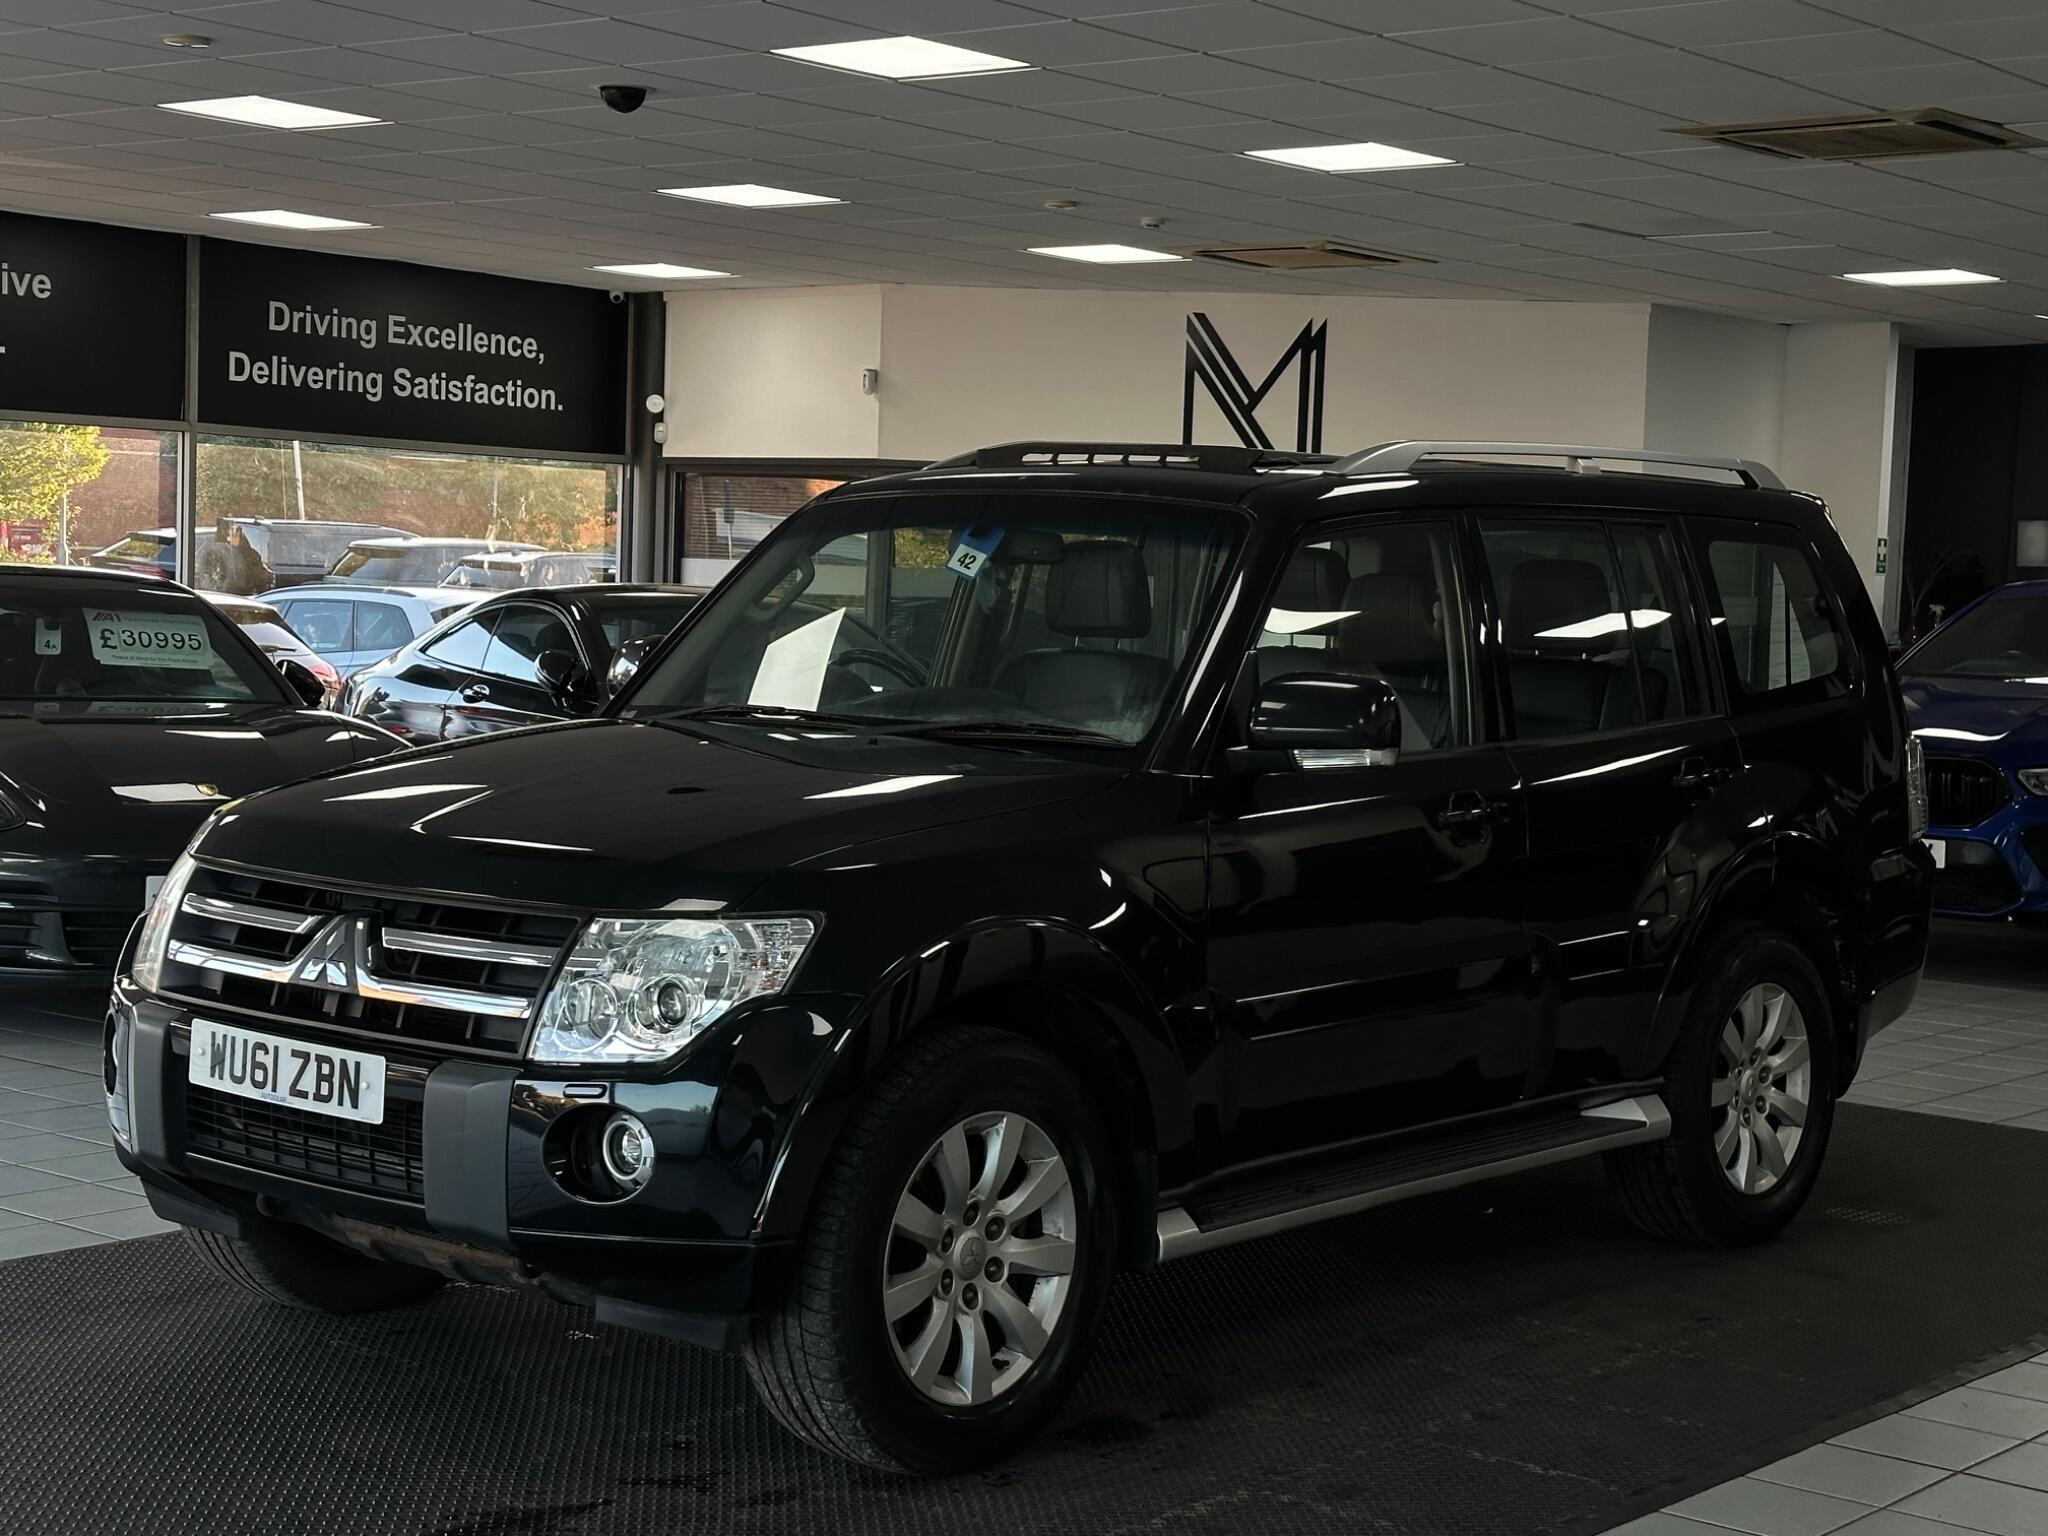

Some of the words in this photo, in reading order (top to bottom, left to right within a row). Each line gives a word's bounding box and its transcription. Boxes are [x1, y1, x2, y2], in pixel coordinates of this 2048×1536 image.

[268, 301, 377, 349] Driving
[387, 314, 545, 365] Excellence,
[228, 351, 383, 401] Delivering
[392, 367, 564, 411] Satisfaction.
[957, 552, 977, 570] 42
[100, 628, 202, 650] £30995
[210, 1031, 280, 1093] WU61
[289, 1048, 361, 1110] ZBN
